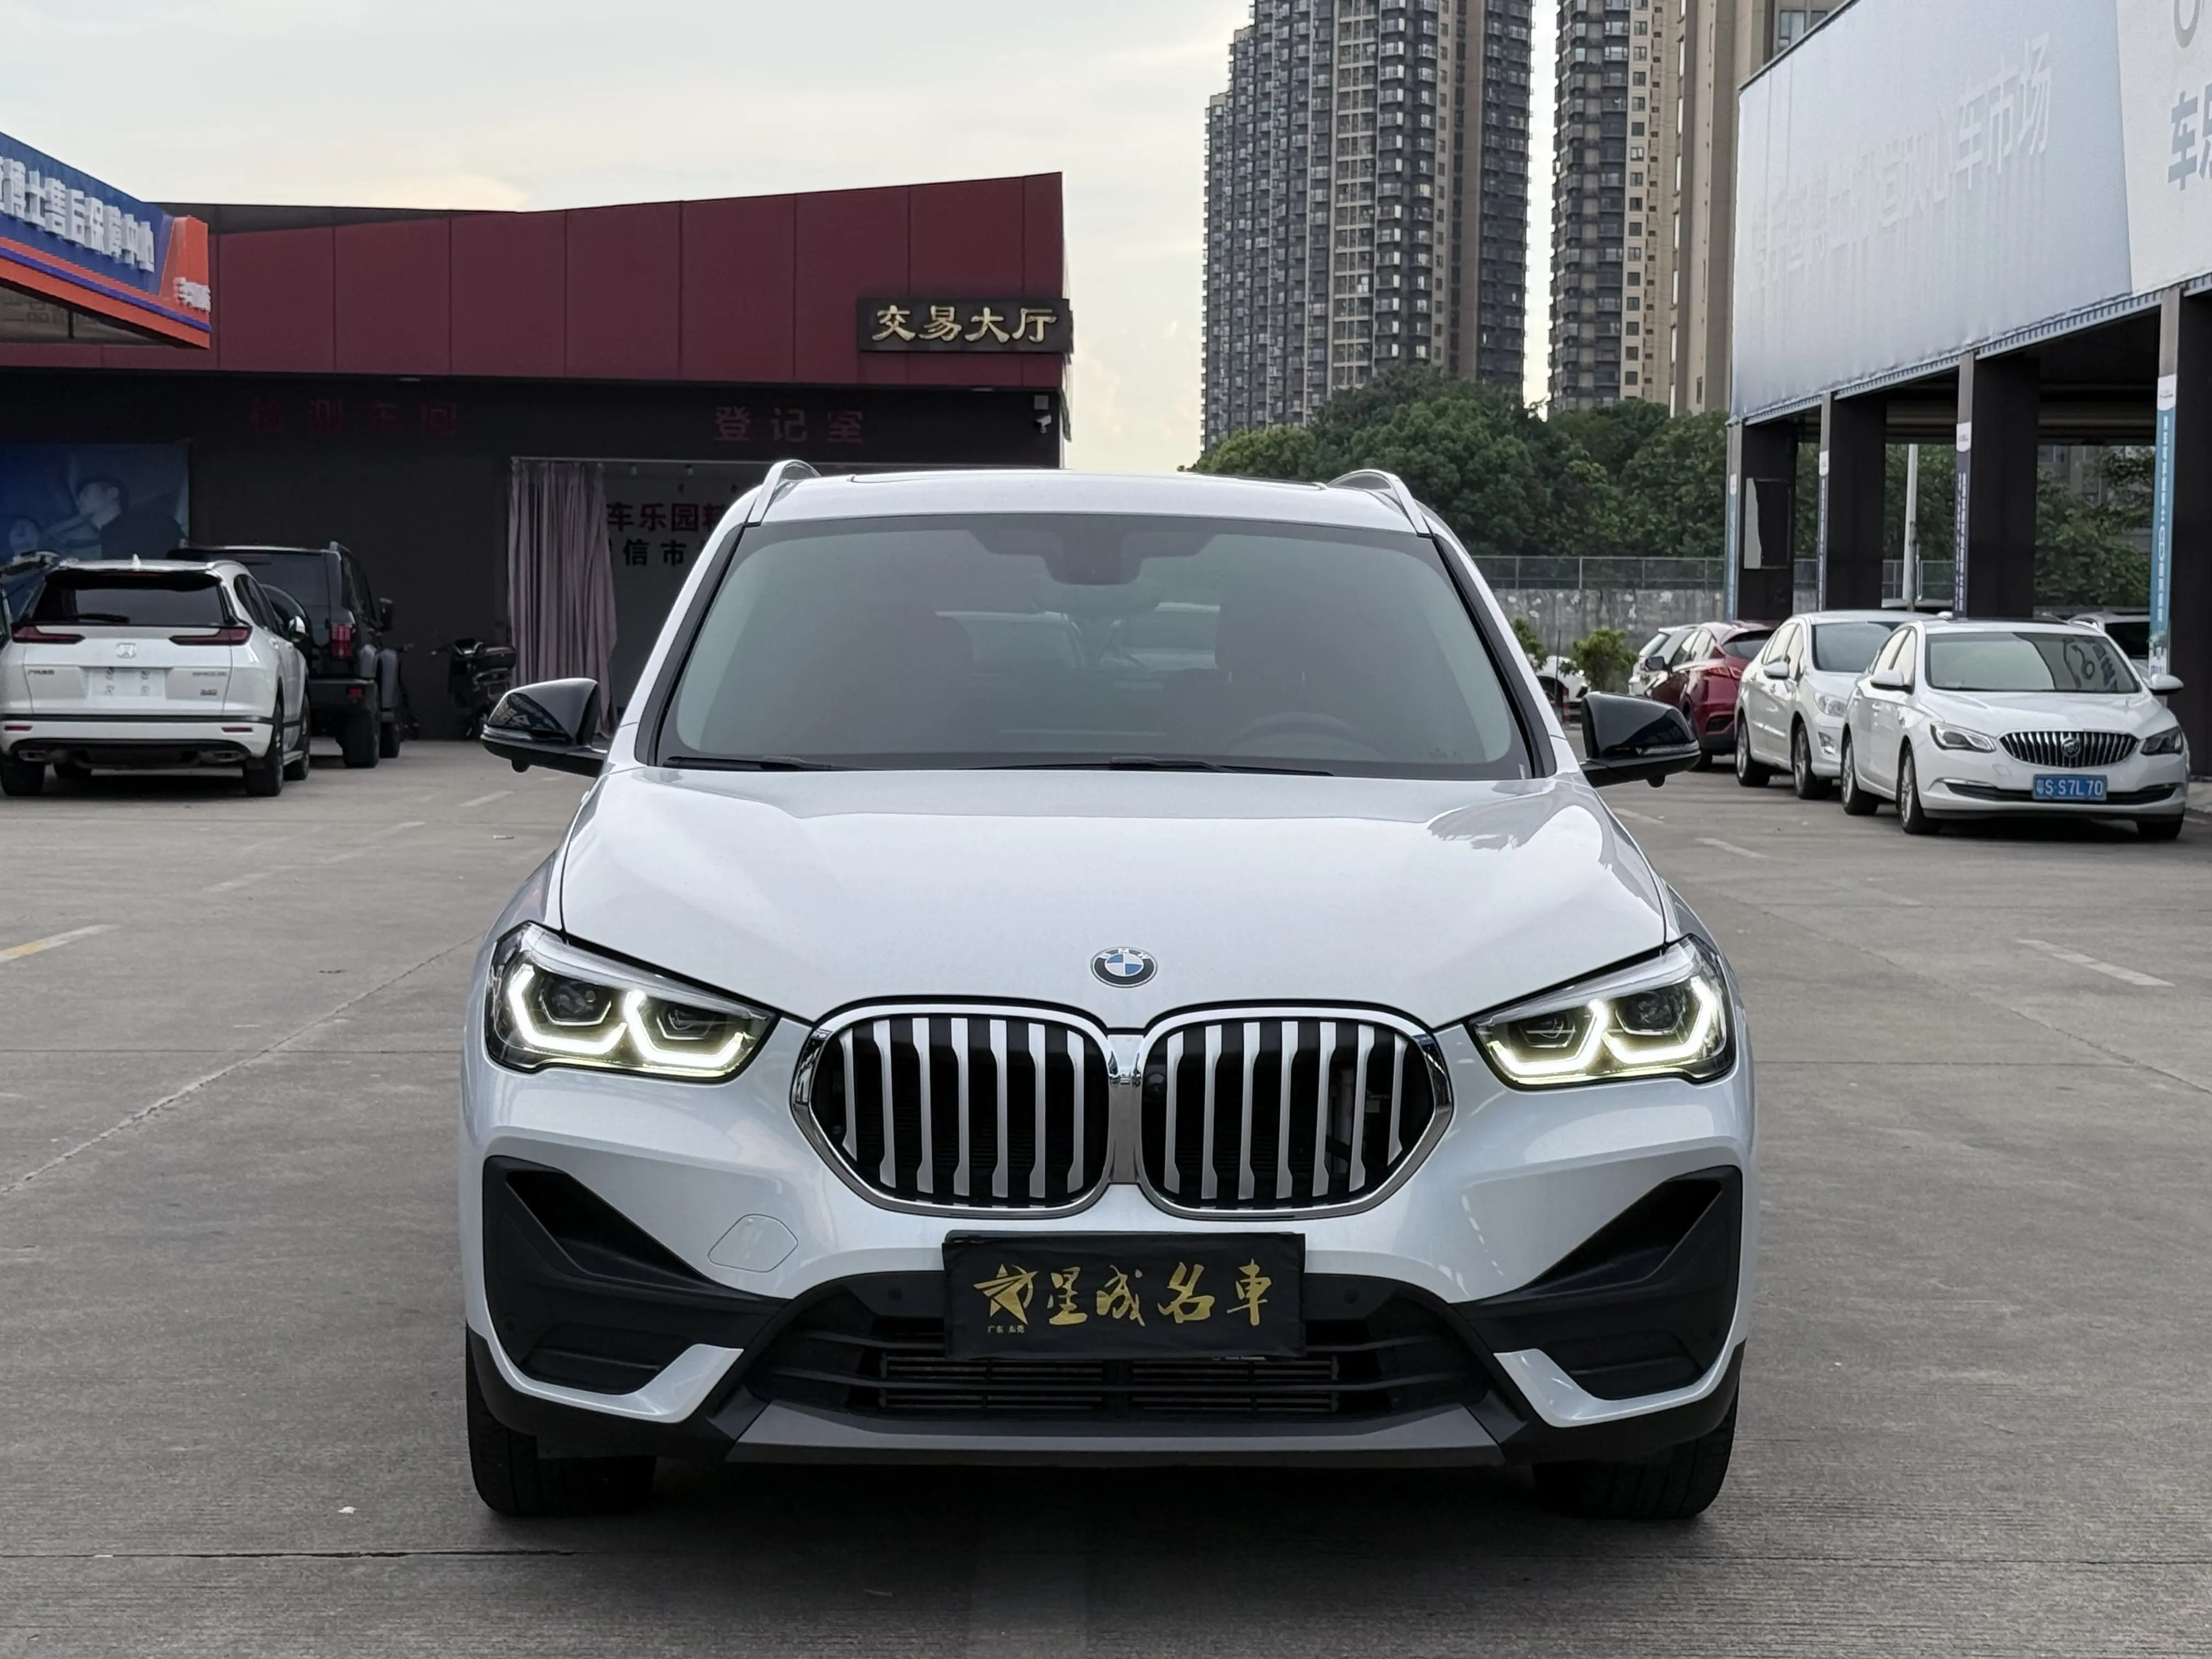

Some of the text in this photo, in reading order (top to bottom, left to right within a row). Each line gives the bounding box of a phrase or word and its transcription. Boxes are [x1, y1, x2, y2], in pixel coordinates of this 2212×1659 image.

[2168, 82, 2212, 191] 车
[872, 305, 1057, 343] 交易大厅
[714, 405, 864, 444] 登记室
